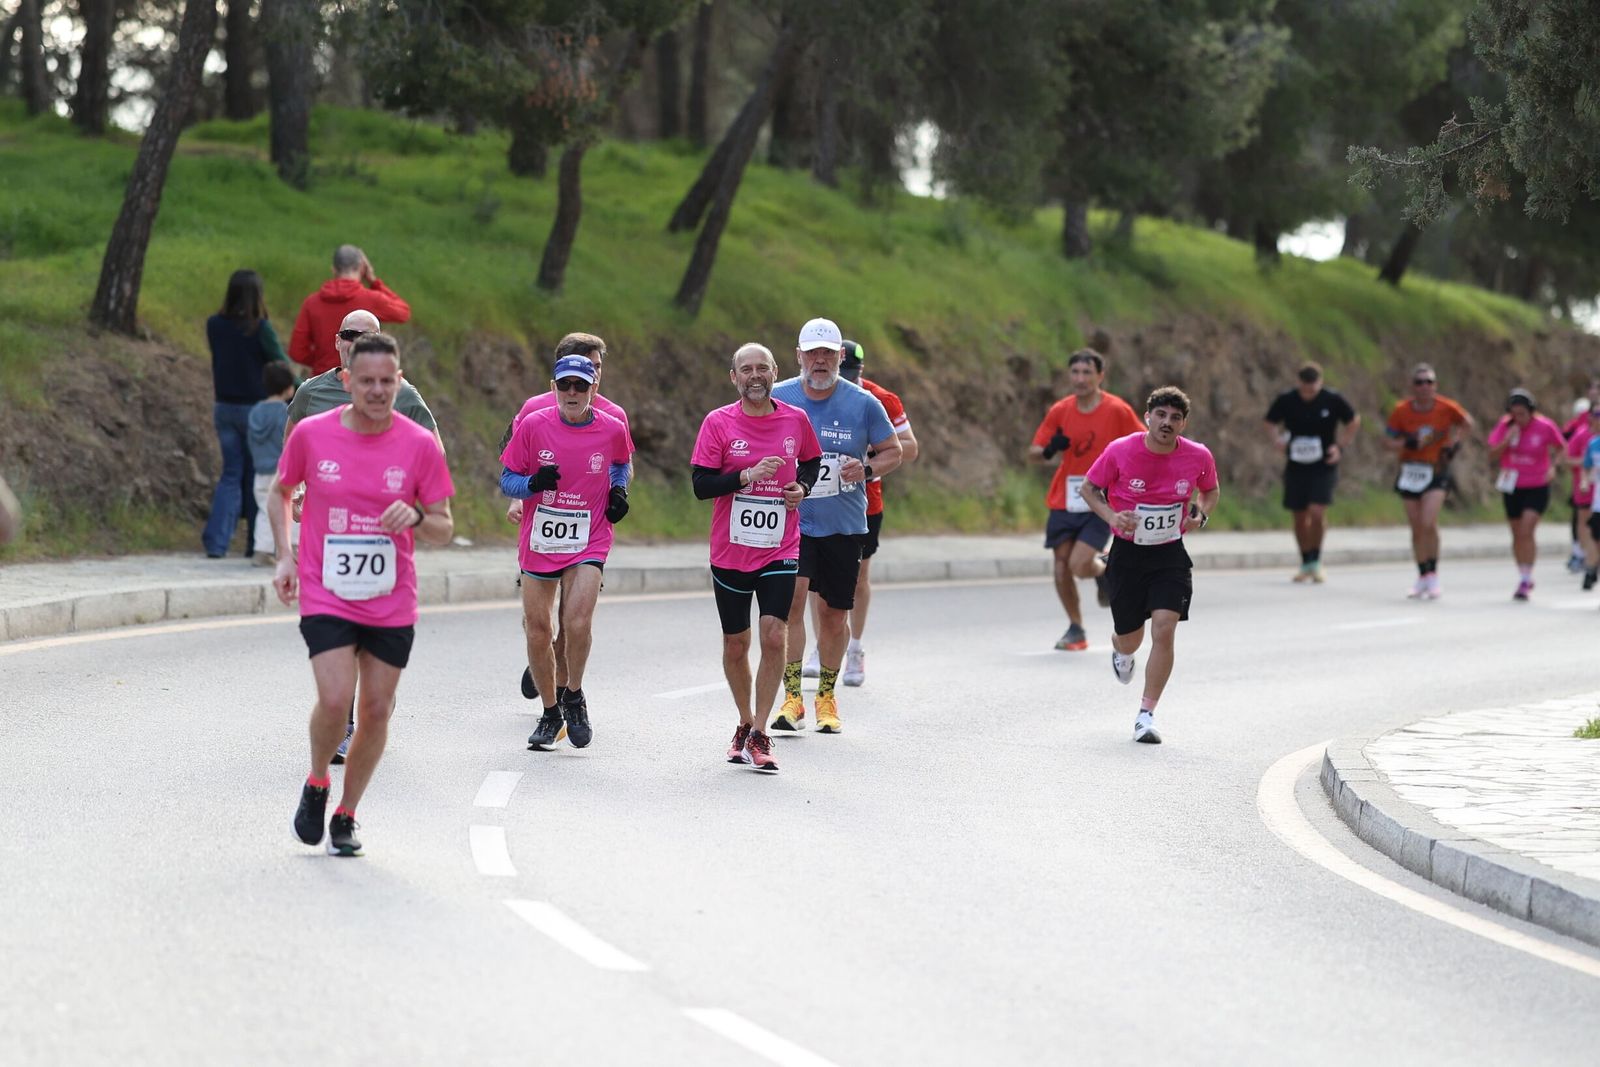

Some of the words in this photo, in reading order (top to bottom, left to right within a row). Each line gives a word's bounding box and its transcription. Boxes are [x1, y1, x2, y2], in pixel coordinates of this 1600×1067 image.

[821, 430, 837, 438] IRON
[838, 432, 852, 440] BOX
[559, 491, 581, 499] Ciudad
[740, 509, 778, 529] 600
[1144, 514, 1176, 530] 615
[542, 520, 579, 540] 601
[337, 554, 385, 576] 370
